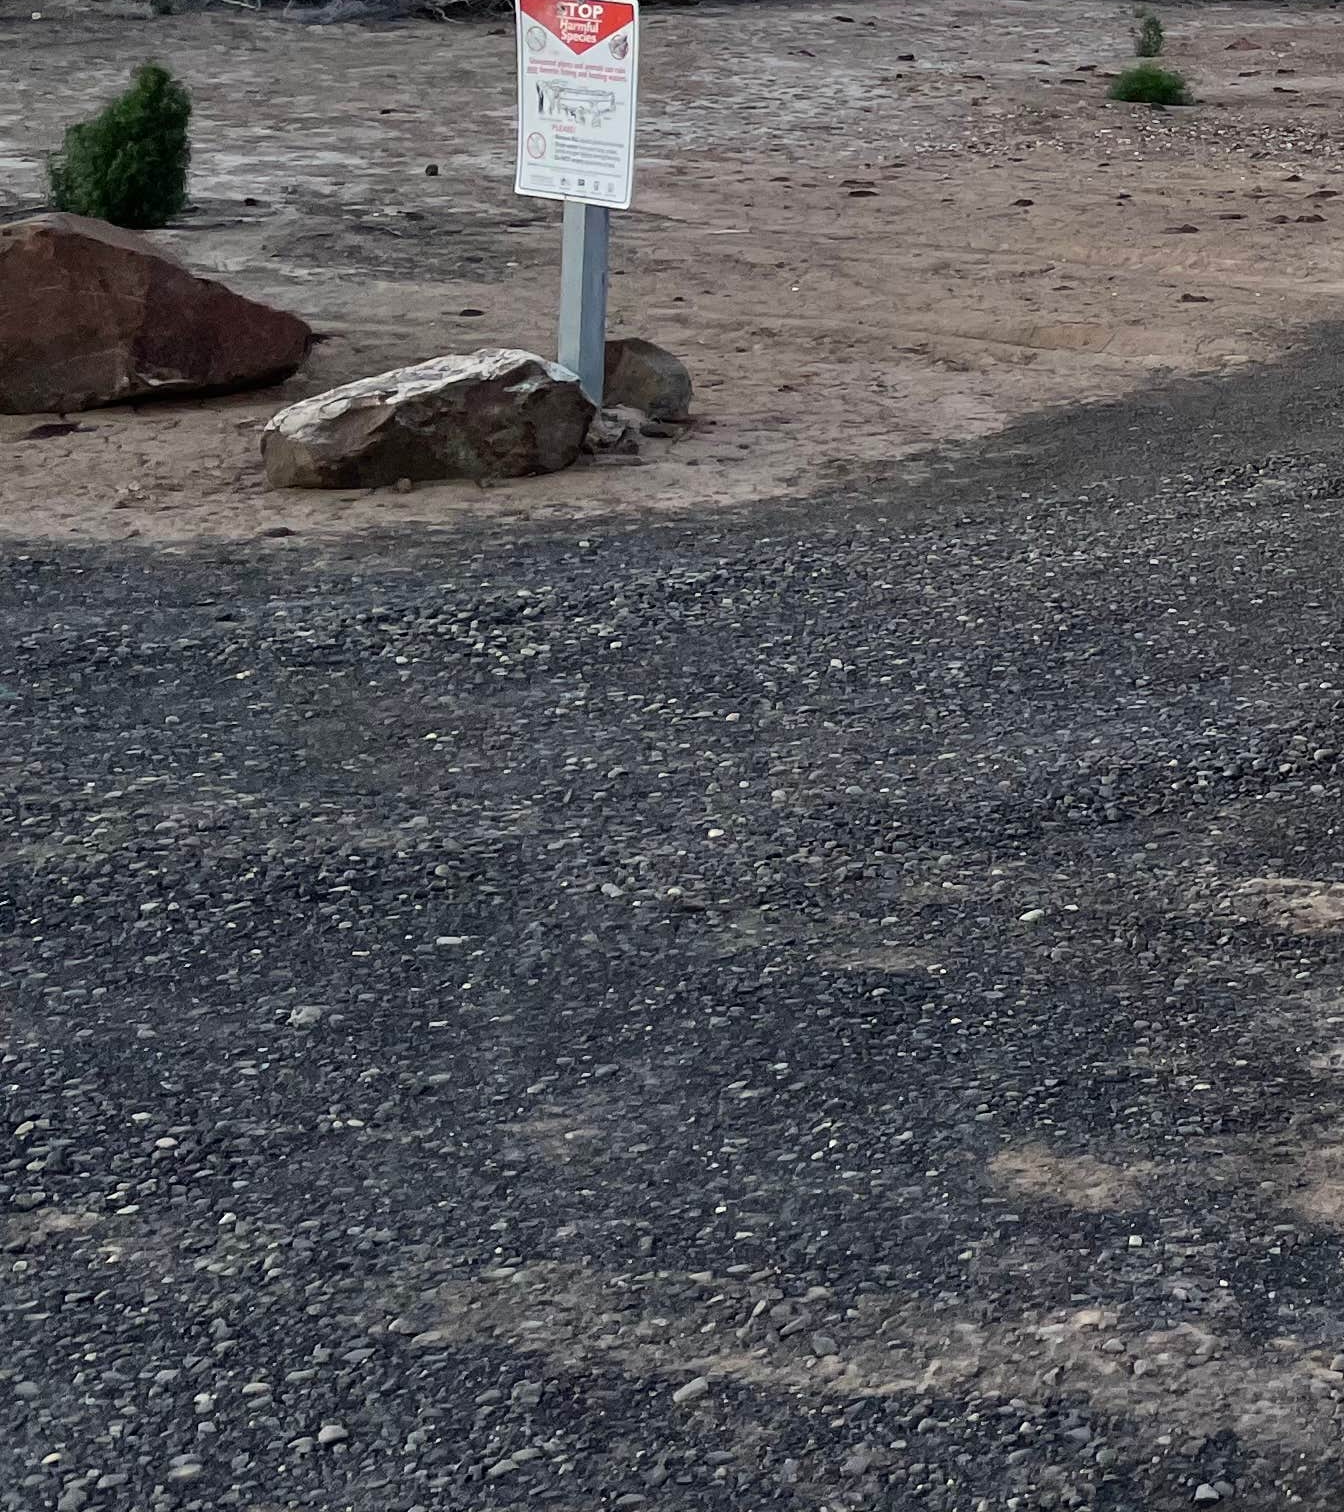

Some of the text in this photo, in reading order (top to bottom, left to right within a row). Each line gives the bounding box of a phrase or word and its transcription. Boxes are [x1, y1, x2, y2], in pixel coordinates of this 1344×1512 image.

[556, 2, 604, 19] STOP
[560, 18, 599, 34] Harmful
[560, 29, 597, 43] Species
